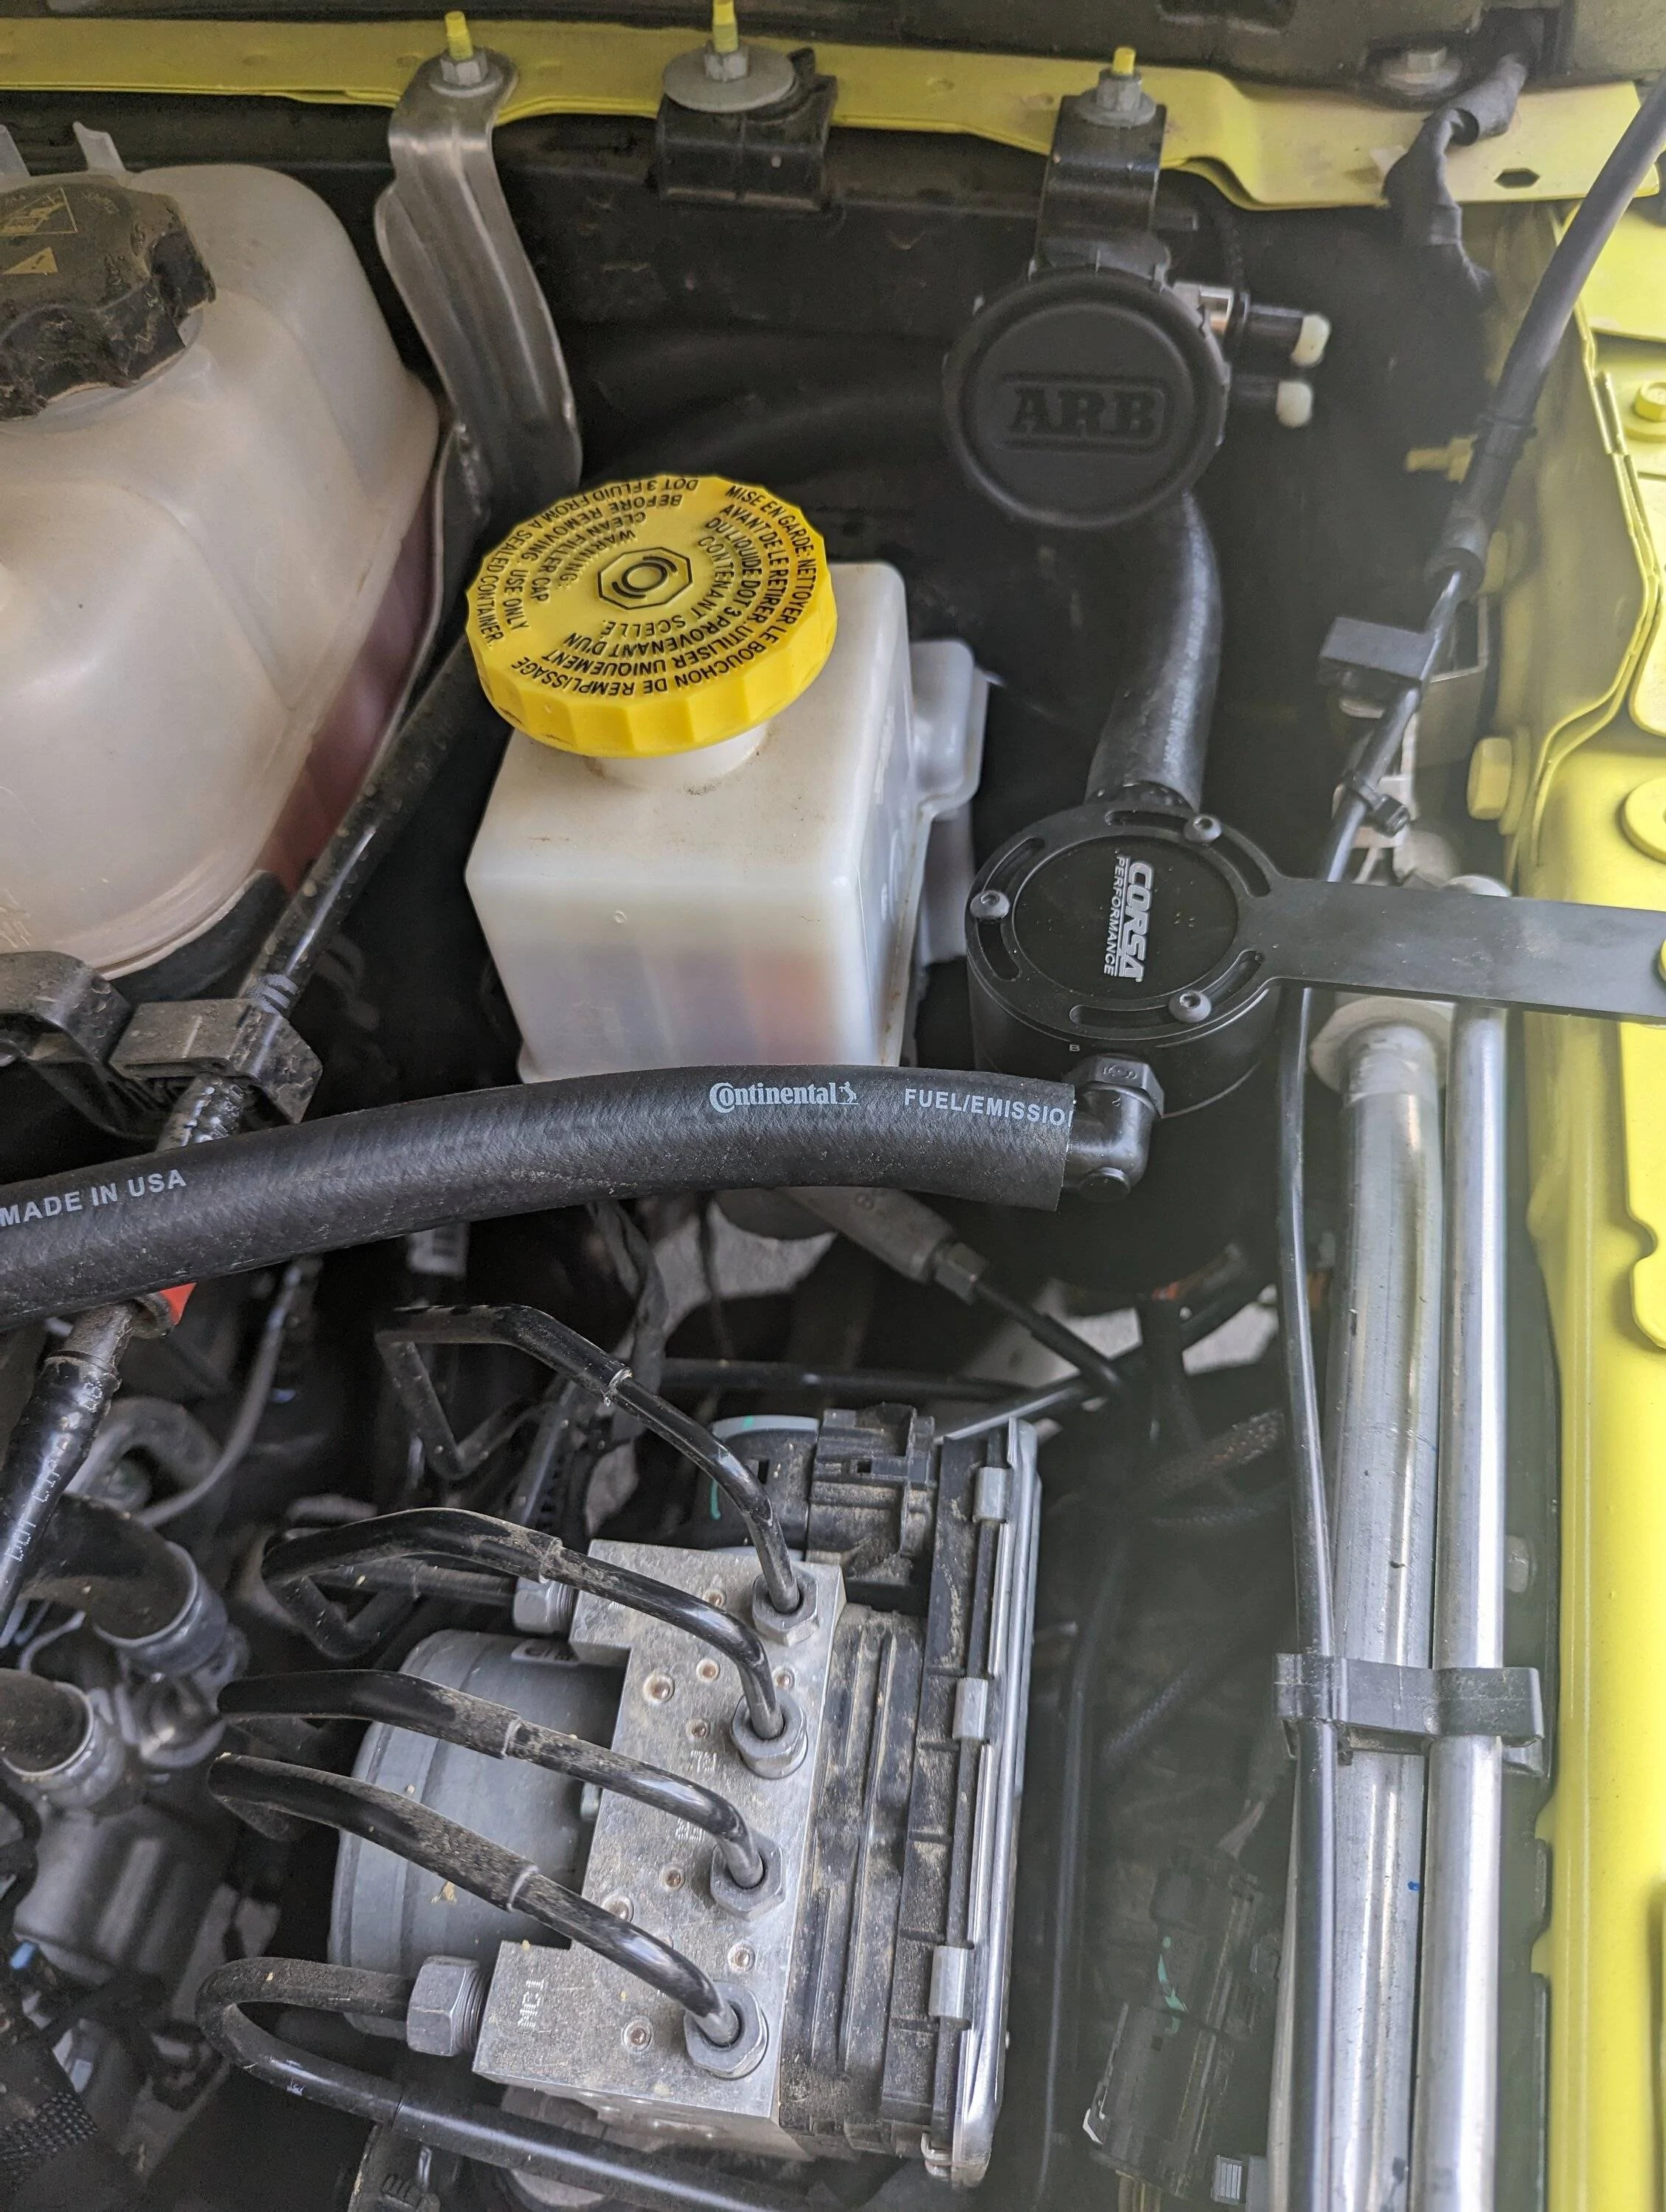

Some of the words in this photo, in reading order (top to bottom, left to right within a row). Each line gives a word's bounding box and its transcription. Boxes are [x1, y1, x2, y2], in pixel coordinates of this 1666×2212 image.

[1010, 386, 1156, 437] ARB
[591, 481, 642, 502] FLUID
[646, 479, 659, 492] 3
[661, 478, 700, 492] DOT
[725, 484, 766, 507] MISE
[541, 495, 591, 523] FROM
[608, 494, 683, 515] BEFORE
[760, 500, 786, 518] EN
[527, 519, 544, 529] A
[586, 511, 647, 538] CLEAN
[704, 517, 735, 534] DU
[719, 504, 771, 534] AVANT
[758, 531, 784, 551] DE
[777, 515, 815, 557] GARDE:
[487, 529, 533, 573] SEALED
[536, 534, 587, 573] FILLER
[724, 530, 763, 577] LIQUIDE
[767, 550, 790, 566] LE
[504, 569, 529, 594] USE
[530, 577, 552, 602] CAP
[690, 535, 735, 620] CONTENANT
[775, 558, 817, 625] NETTOYER
[732, 580, 762, 608] DOT
[501, 598, 530, 630] ONLY
[723, 606, 743, 618] 3
[608, 614, 732, 658] PROVENANT
[671, 625, 754, 669] UTILISER
[758, 625, 788, 644] LE
[510, 656, 636, 697] REMPLISSAGE
[541, 648, 667, 677] UNIQUEMENT
[673, 640, 767, 688] BOUCHON
[642, 678, 668, 695] DE
[1103, 855, 1125, 976] PERFORMANCE
[1118, 858, 1156, 983] CORSA
[709, 1081, 839, 1113] Continental
[0, 1191, 83, 1227] MADE
[91, 1182, 119, 1207] IN
[128, 1169, 188, 1198] USA
